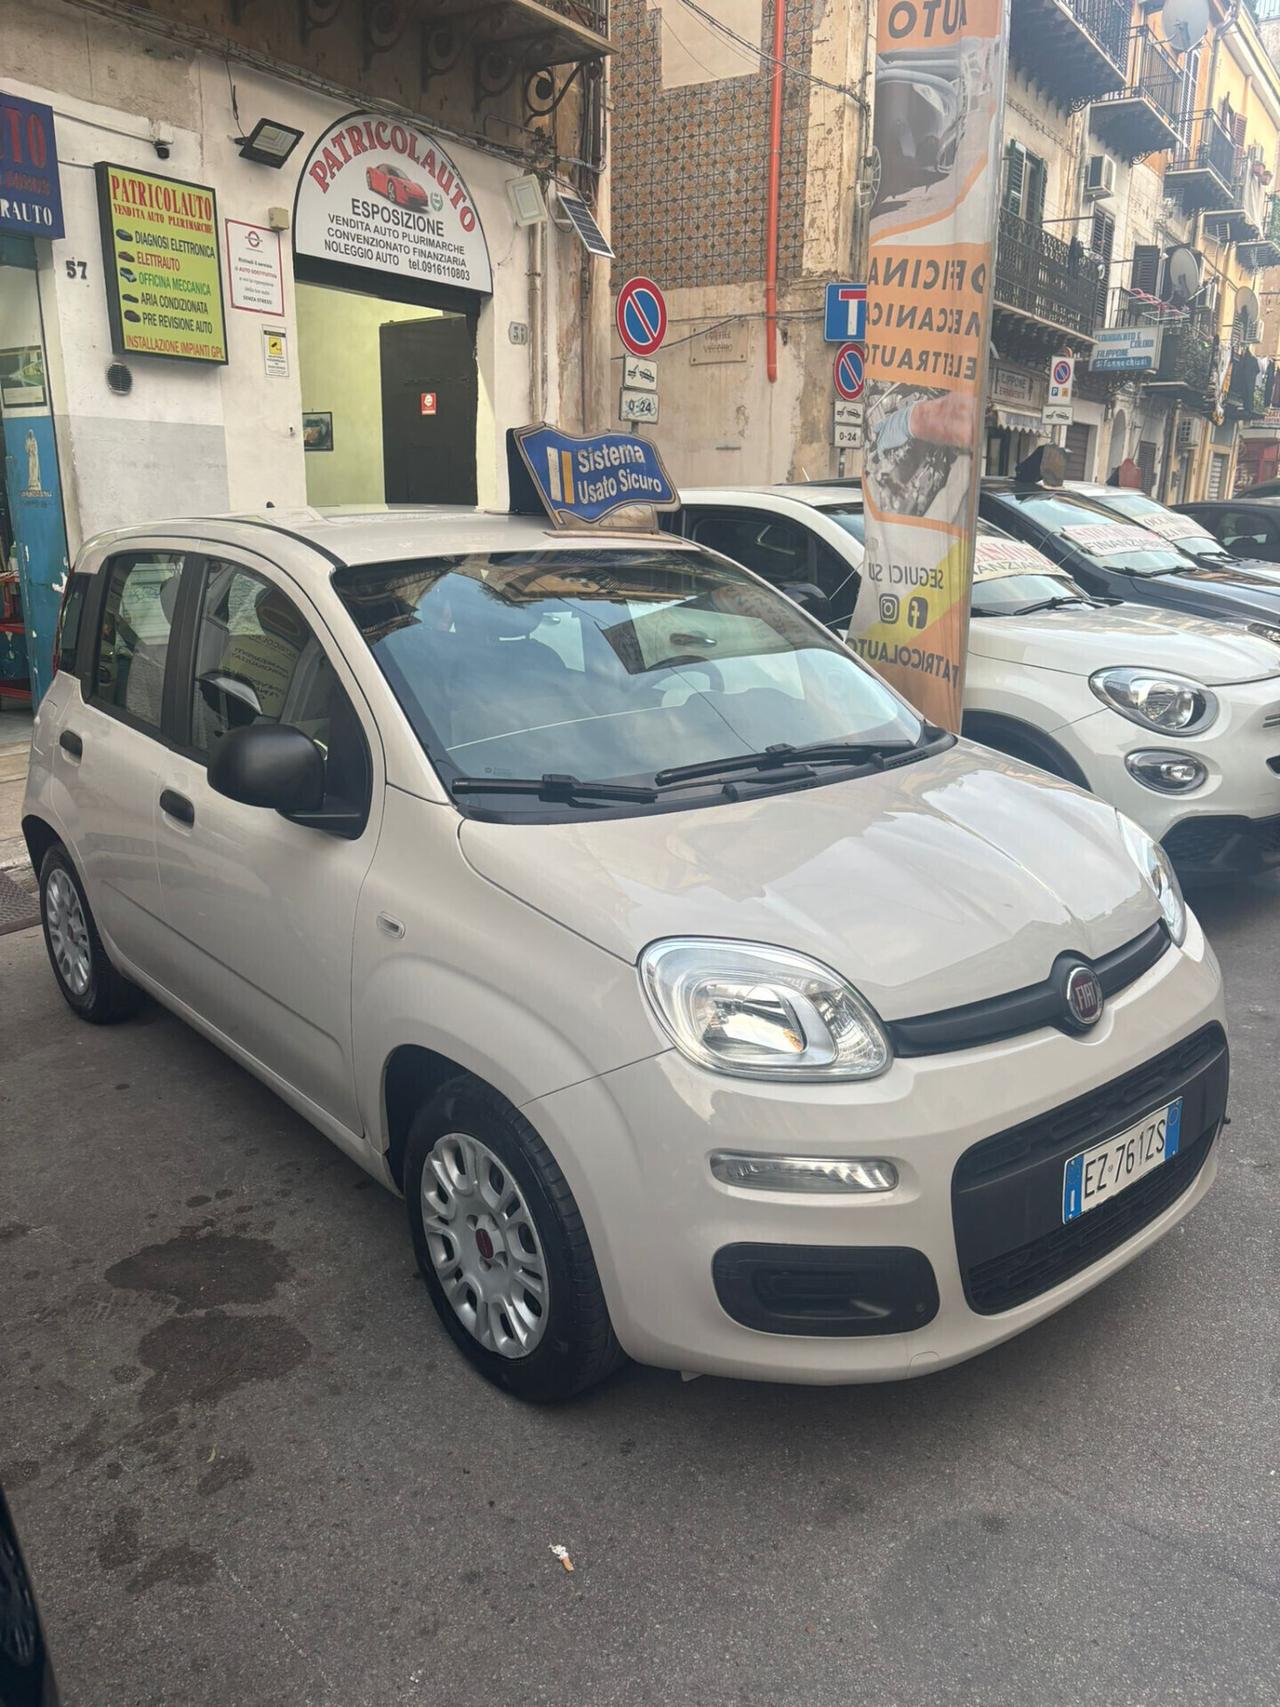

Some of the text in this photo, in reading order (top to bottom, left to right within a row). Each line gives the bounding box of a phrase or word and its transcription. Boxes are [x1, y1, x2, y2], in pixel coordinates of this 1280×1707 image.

[309, 121, 476, 232] PATRICOLAUTO
[111, 175, 213, 222] PATRICOLAUTO
[113, 204, 145, 222] VENDITA
[147, 211, 165, 225] AUTO
[351, 198, 445, 237] ESPOSIZIONE
[135, 230, 216, 259] DIAGNOSI ELETTRONICA
[327, 227, 467, 267] CONVENZIONATO FINANZIARIA
[328, 213, 465, 255] VENDITA AUTO PLURIMARCHE
[137, 251, 181, 271] ELETTRAUTO
[324, 239, 374, 261] NOLEGGIO
[375, 251, 400, 266] AUTO
[65, 258, 88, 280] 57
[139, 272, 212, 297] OFFICINA MECCANICA
[140, 292, 209, 315] ARIA CONDIZIONATA
[142, 312, 213, 334] PRE REVISIONE AUTO
[126, 335, 179, 354] INSTALLAZIONE
[180, 341, 210, 358] IMPIANTI
[577, 443, 646, 473] Sistema
[577, 468, 662, 505] Usato Sicuro
[1075, 980, 1095, 1012] FIAT
